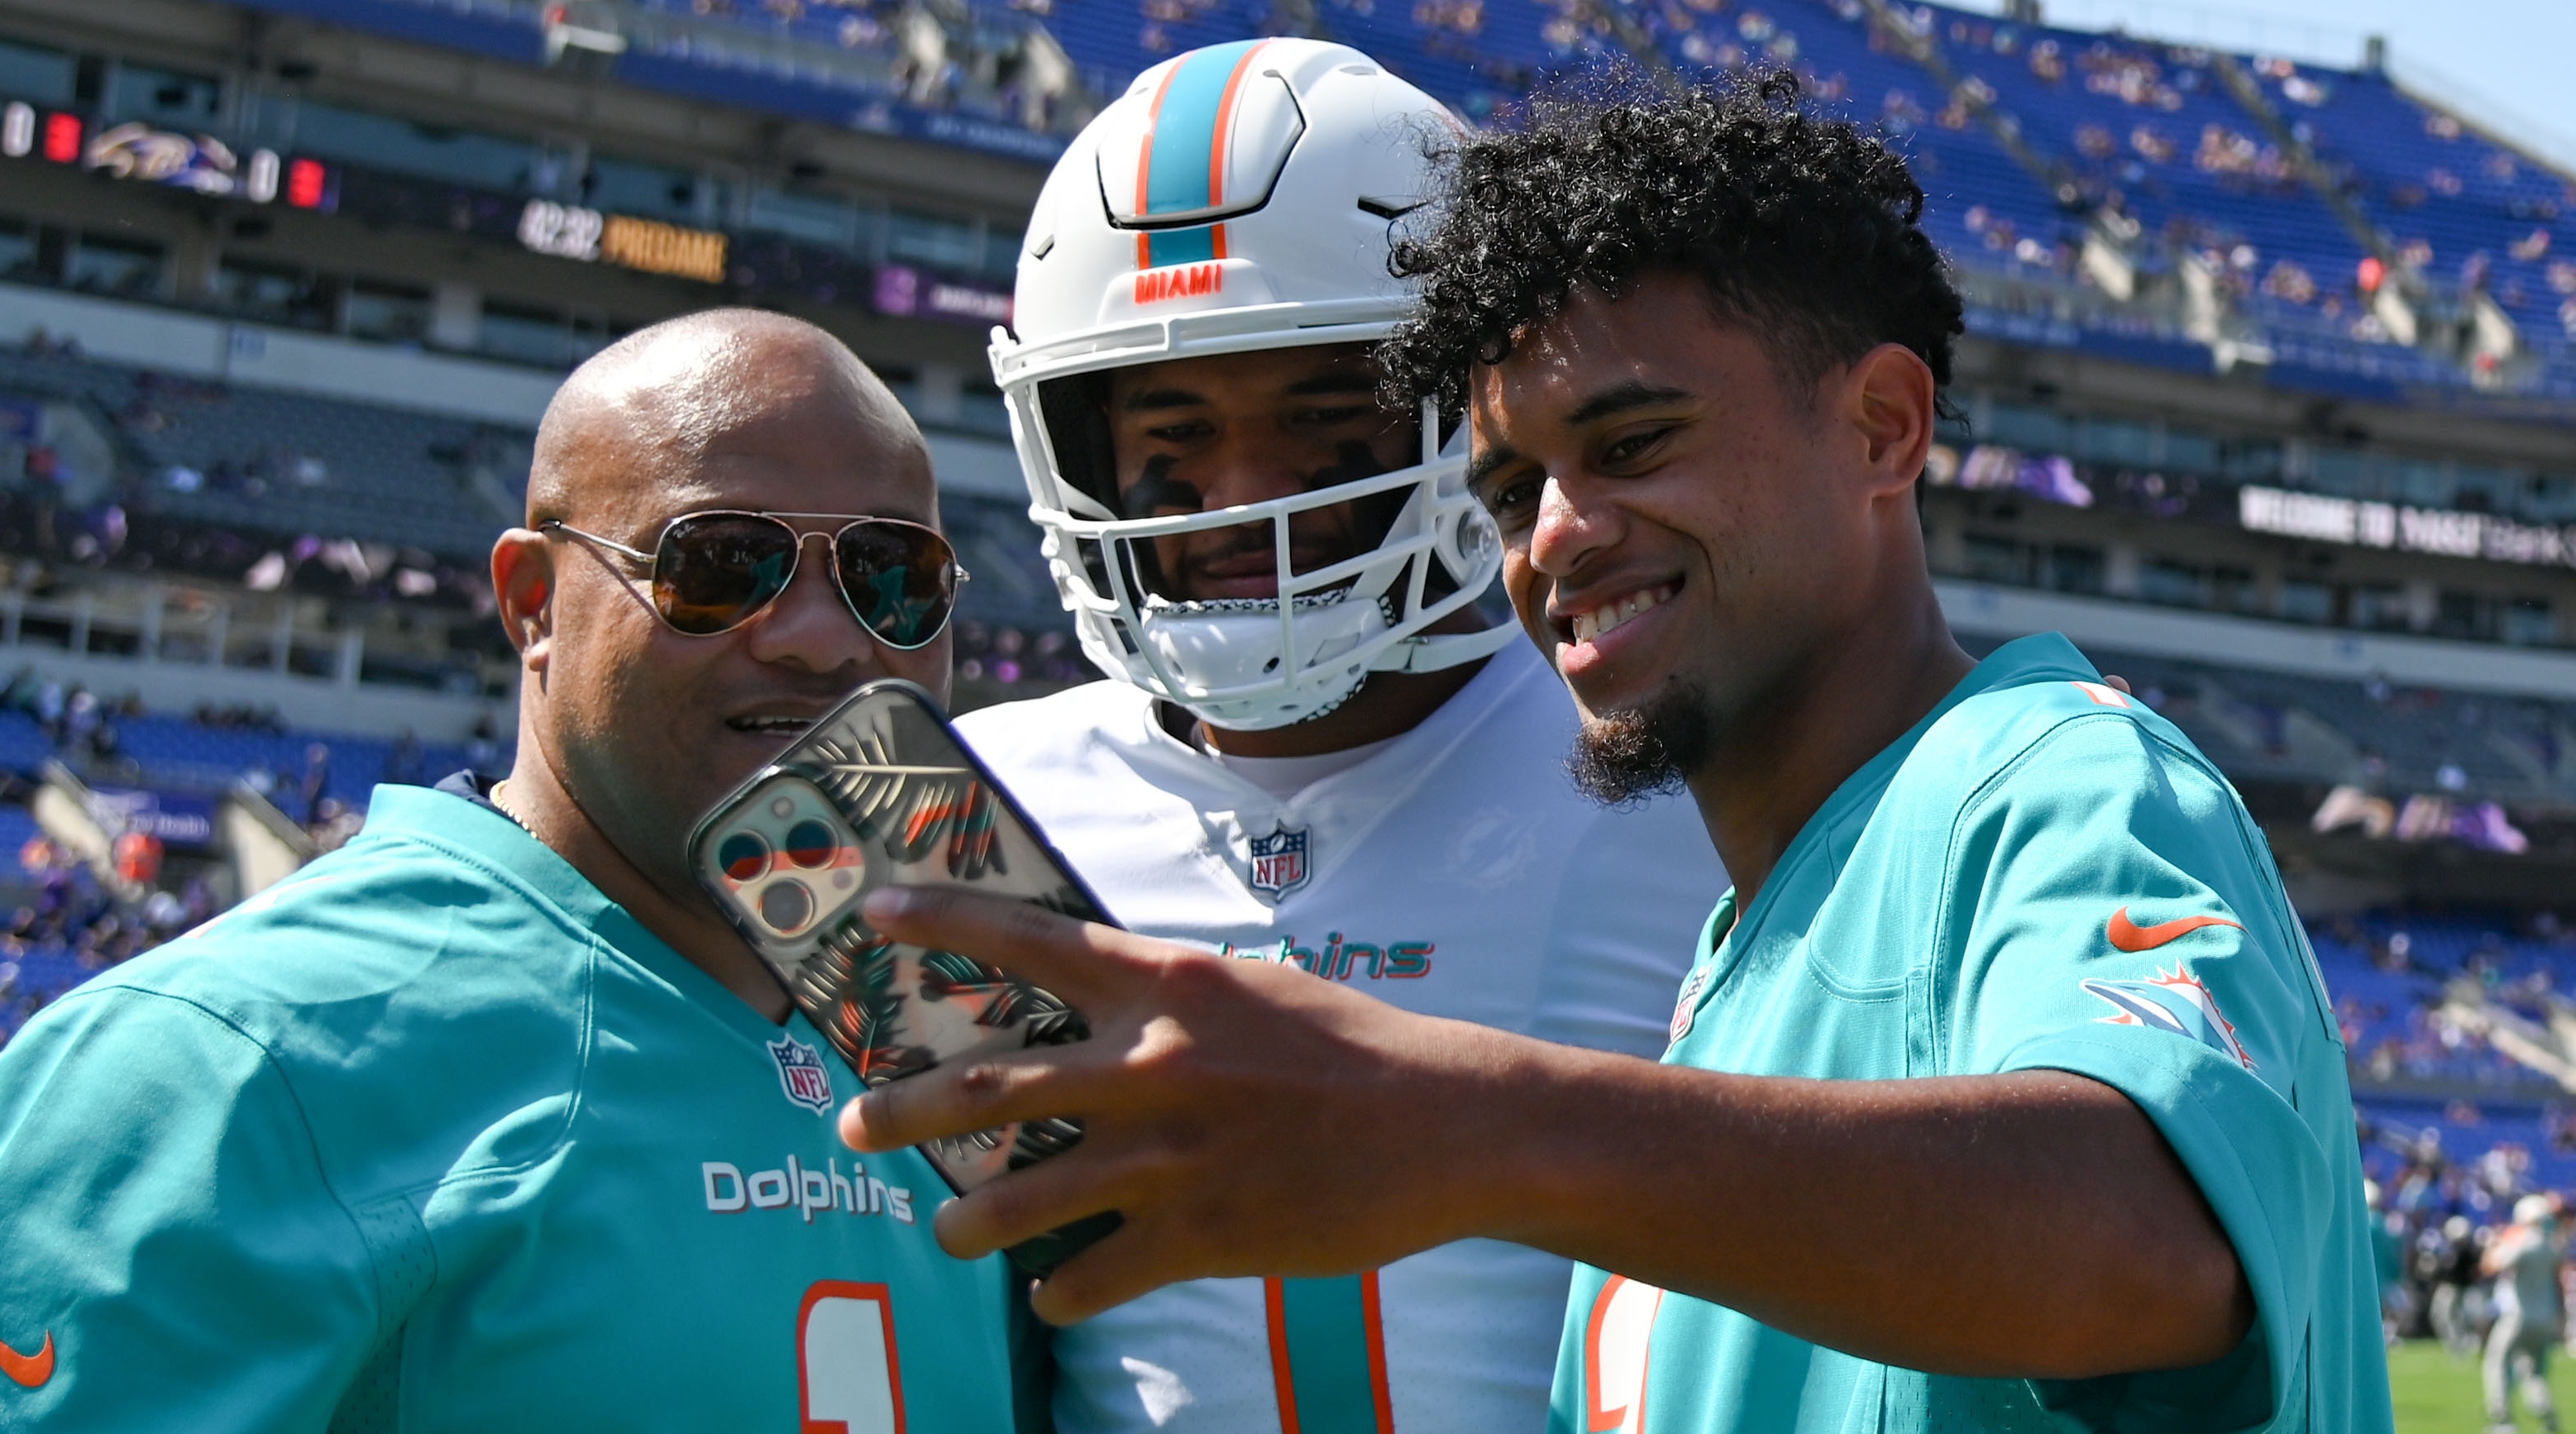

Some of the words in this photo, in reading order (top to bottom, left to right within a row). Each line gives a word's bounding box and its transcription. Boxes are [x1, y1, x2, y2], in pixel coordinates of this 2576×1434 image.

[1135, 263, 1222, 304] MIAMI
[1255, 853, 1301, 887] NFL
[1219, 931, 1436, 981] hins
[787, 1067, 830, 1100] NFL
[702, 1154, 916, 1224] Dolphins
